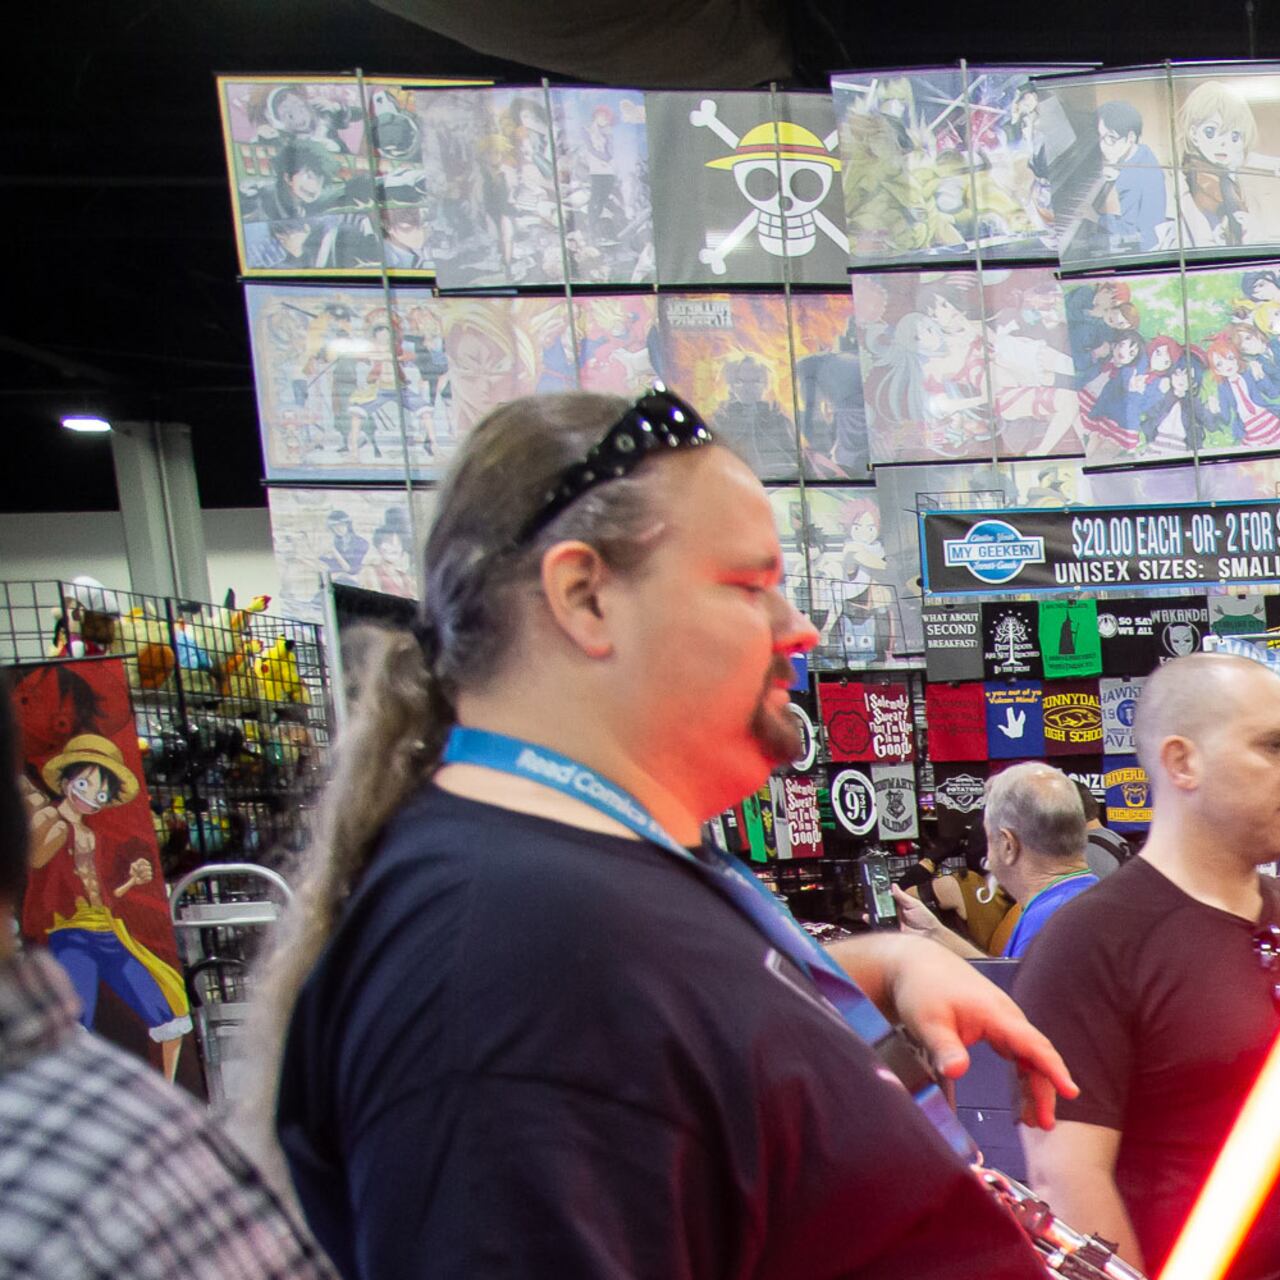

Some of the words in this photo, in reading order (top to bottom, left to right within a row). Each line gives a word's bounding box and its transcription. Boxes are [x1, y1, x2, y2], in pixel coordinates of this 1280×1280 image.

[1072, 516, 1134, 559] $20.00
[1136, 514, 1182, 555] EACH
[1185, 513, 1223, 553] -OR-
[1226, 512, 1238, 552] 2
[1241, 510, 1275, 551] FOR
[952, 546, 972, 559] MY
[978, 543, 1035, 558] GEEKERY
[1054, 560, 1130, 584] UNISEX
[1139, 559, 1204, 580] SIZES:
[950, 612, 979, 622] ABOUT
[1118, 616, 1132, 626] SO
[1150, 608, 1209, 623] WAKANDA
[926, 624, 976, 636] SECOND
[1118, 627, 1135, 636] WE
[1137, 626, 1154, 636] ALL
